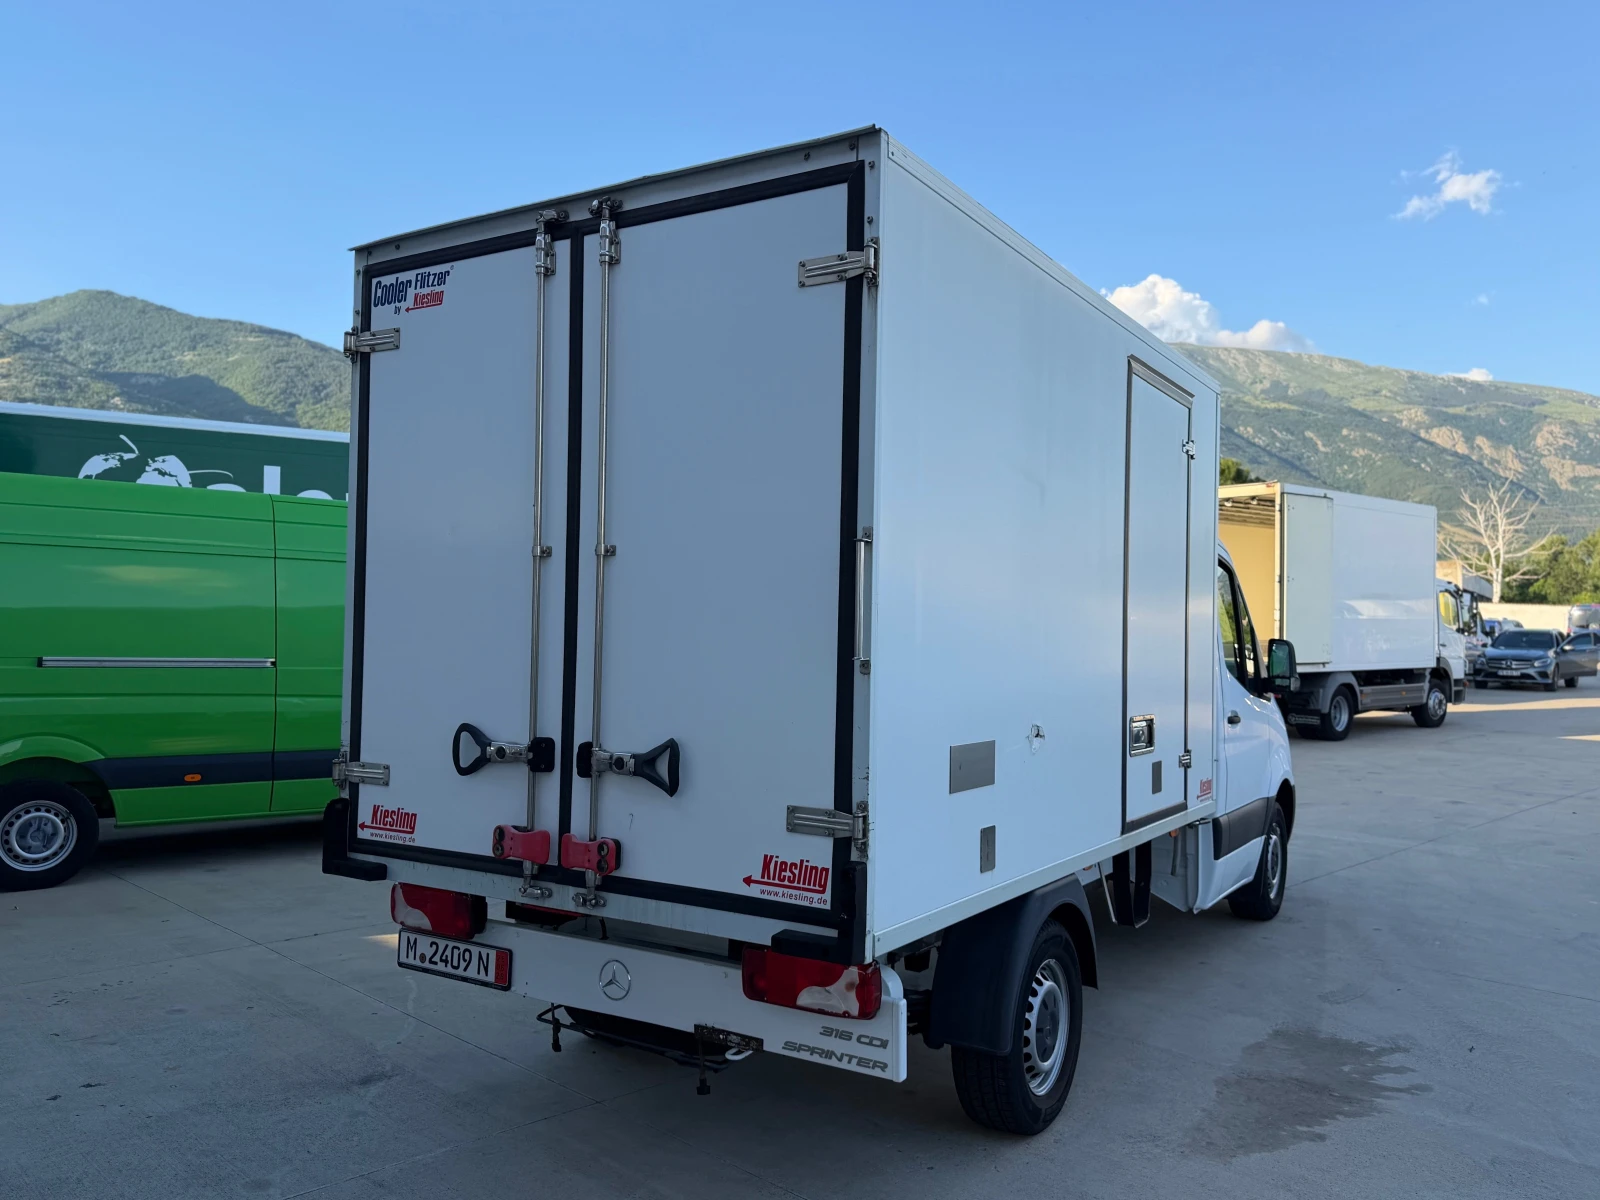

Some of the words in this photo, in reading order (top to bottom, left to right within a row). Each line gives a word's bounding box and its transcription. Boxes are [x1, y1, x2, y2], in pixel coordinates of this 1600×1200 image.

[373, 277, 412, 307] Cooler
[394, 305, 402, 315] by
[413, 290, 444, 307] Kiesling
[371, 804, 417, 831] Kiesling
[370, 831, 416, 843] www.kiesling.de
[761, 854, 830, 890] Kiesling
[760, 888, 828, 905] www.kiesling.de
[406, 935, 418, 960] M
[428, 941, 473, 972] 2409
[477, 951, 490, 977] N
[819, 1025, 854, 1041] 316
[856, 1034, 889, 1049] CDI
[781, 1040, 889, 1072] SPRINTER
